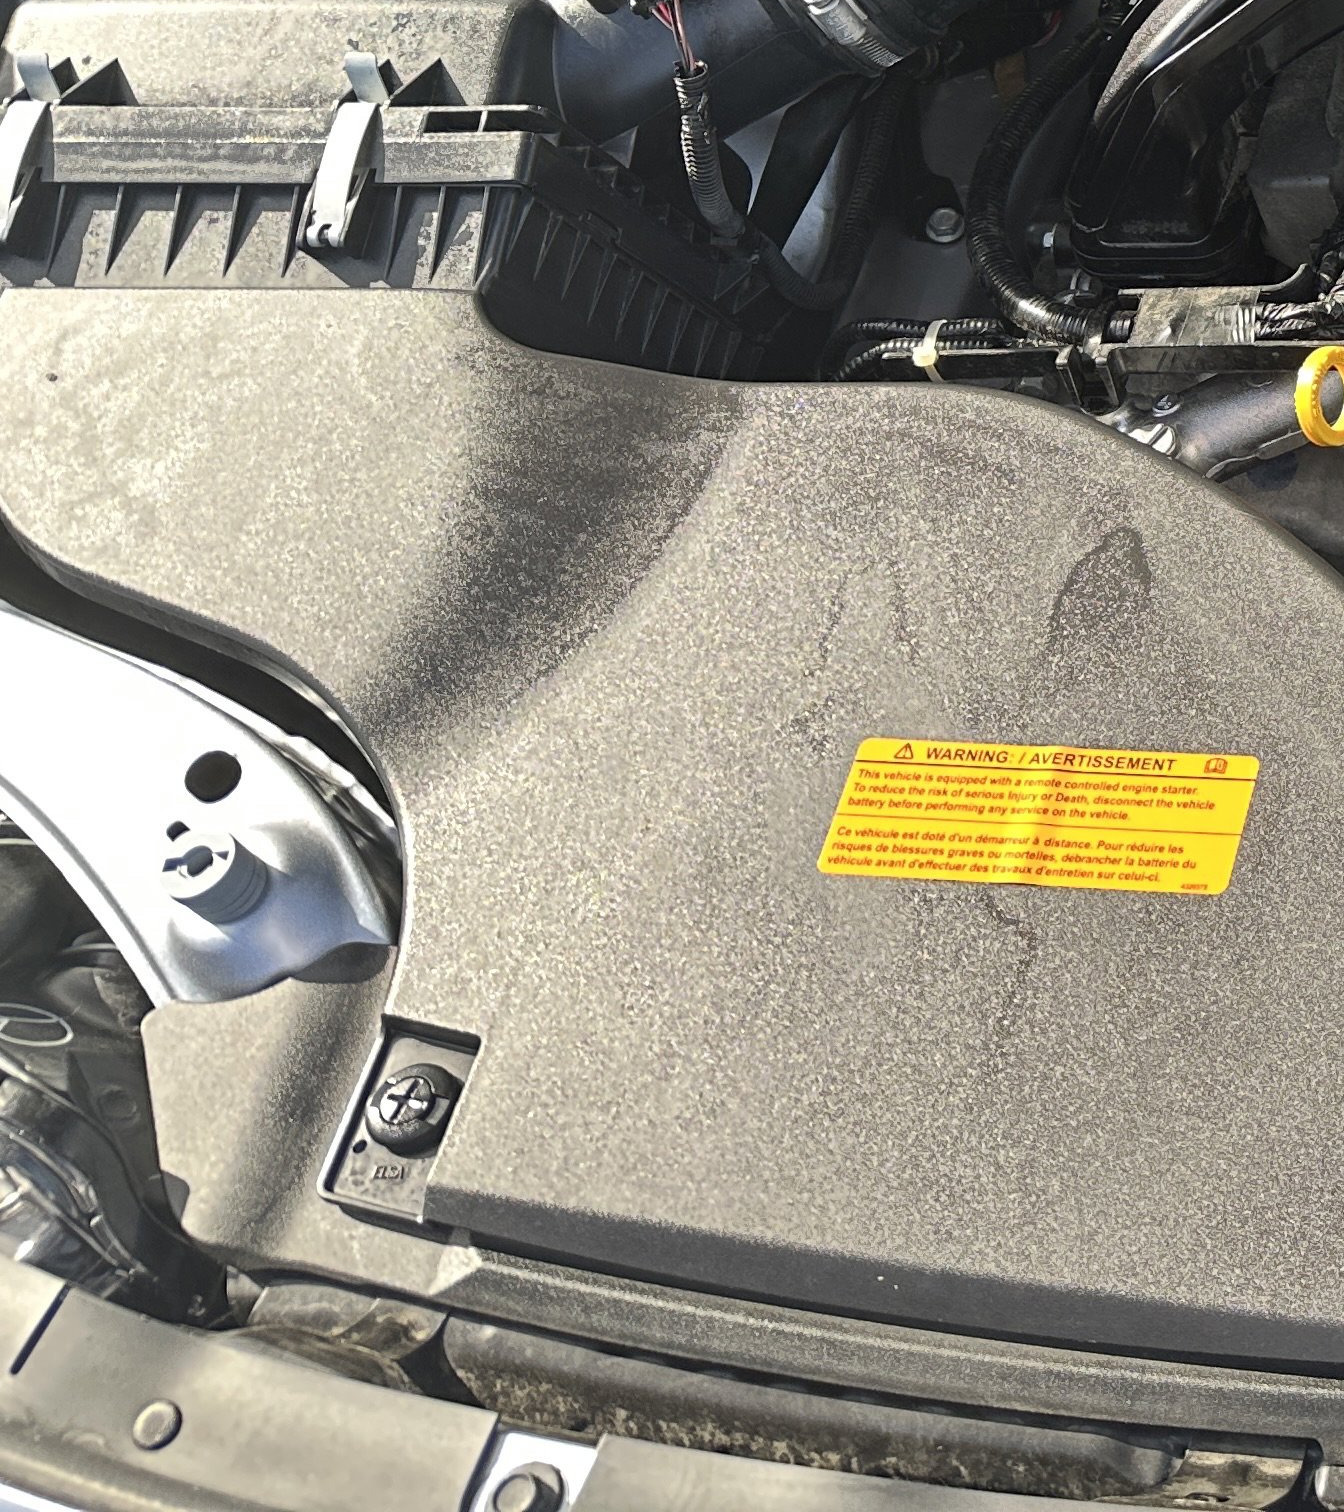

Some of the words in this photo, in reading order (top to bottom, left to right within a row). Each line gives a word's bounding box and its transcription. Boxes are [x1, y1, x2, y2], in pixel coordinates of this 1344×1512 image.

[1028, 752, 1177, 771] AVERTISSEMENT
[857, 769, 881, 778] This
[883, 770, 922, 781] vehicle
[924, 772, 935, 781] is
[935, 773, 987, 786] equipped
[989, 775, 1013, 785] with
[1023, 778, 1062, 788] remote
[1063, 779, 1120, 791] controlled
[1121, 783, 1159, 794] engine
[846, 796, 885, 809] battery
[887, 798, 923, 809] before
[924, 800, 986, 814] performing
[986, 805, 1007, 815] any
[1009, 805, 1049, 815] service
[1051, 808, 1066, 816] on
[1068, 808, 1087, 817] the
[852, 782, 866, 792] To
[867, 783, 906, 794] reduce
[907, 785, 926, 795] the
[927, 786, 948, 796] risk
[950, 788, 964, 797] of
[964, 788, 1005, 799] serious
[1054, 792, 1092, 804] Death,
[1092, 795, 1154, 806] disconnect
[1155, 798, 1173, 807] the
[1175, 799, 1215, 810] vehicle
[836, 826, 852, 836] Ce
[854, 827, 900, 838] véhicule
[901, 829, 920, 839] est
[921, 830, 946, 841] doté
[948, 832, 973, 842] d'un
[974, 833, 1029, 845] démarreur
[1043, 837, 1094, 849] distance.
[1096, 840, 1124, 850] Pour
[1125, 841, 1165, 853] réduire
[1167, 843, 1185, 854] les
[826, 855, 873, 866] véhicule
[874, 857, 906, 868] avant
[907, 859, 966, 871] d'effectuer
[968, 862, 989, 872] des
[991, 864, 1033, 875] travaux
[1034, 866, 1094, 878] d'entretien
[1096, 869, 1116, 879] sur
[830, 841, 872, 853] risques
[874, 843, 889, 852] de
[891, 844, 945, 855] blessures
[946, 849, 984, 859] graves
[1124, 856, 1135, 866] la
[1136, 857, 1180, 868] batterie
[1181, 859, 1197, 869] du
